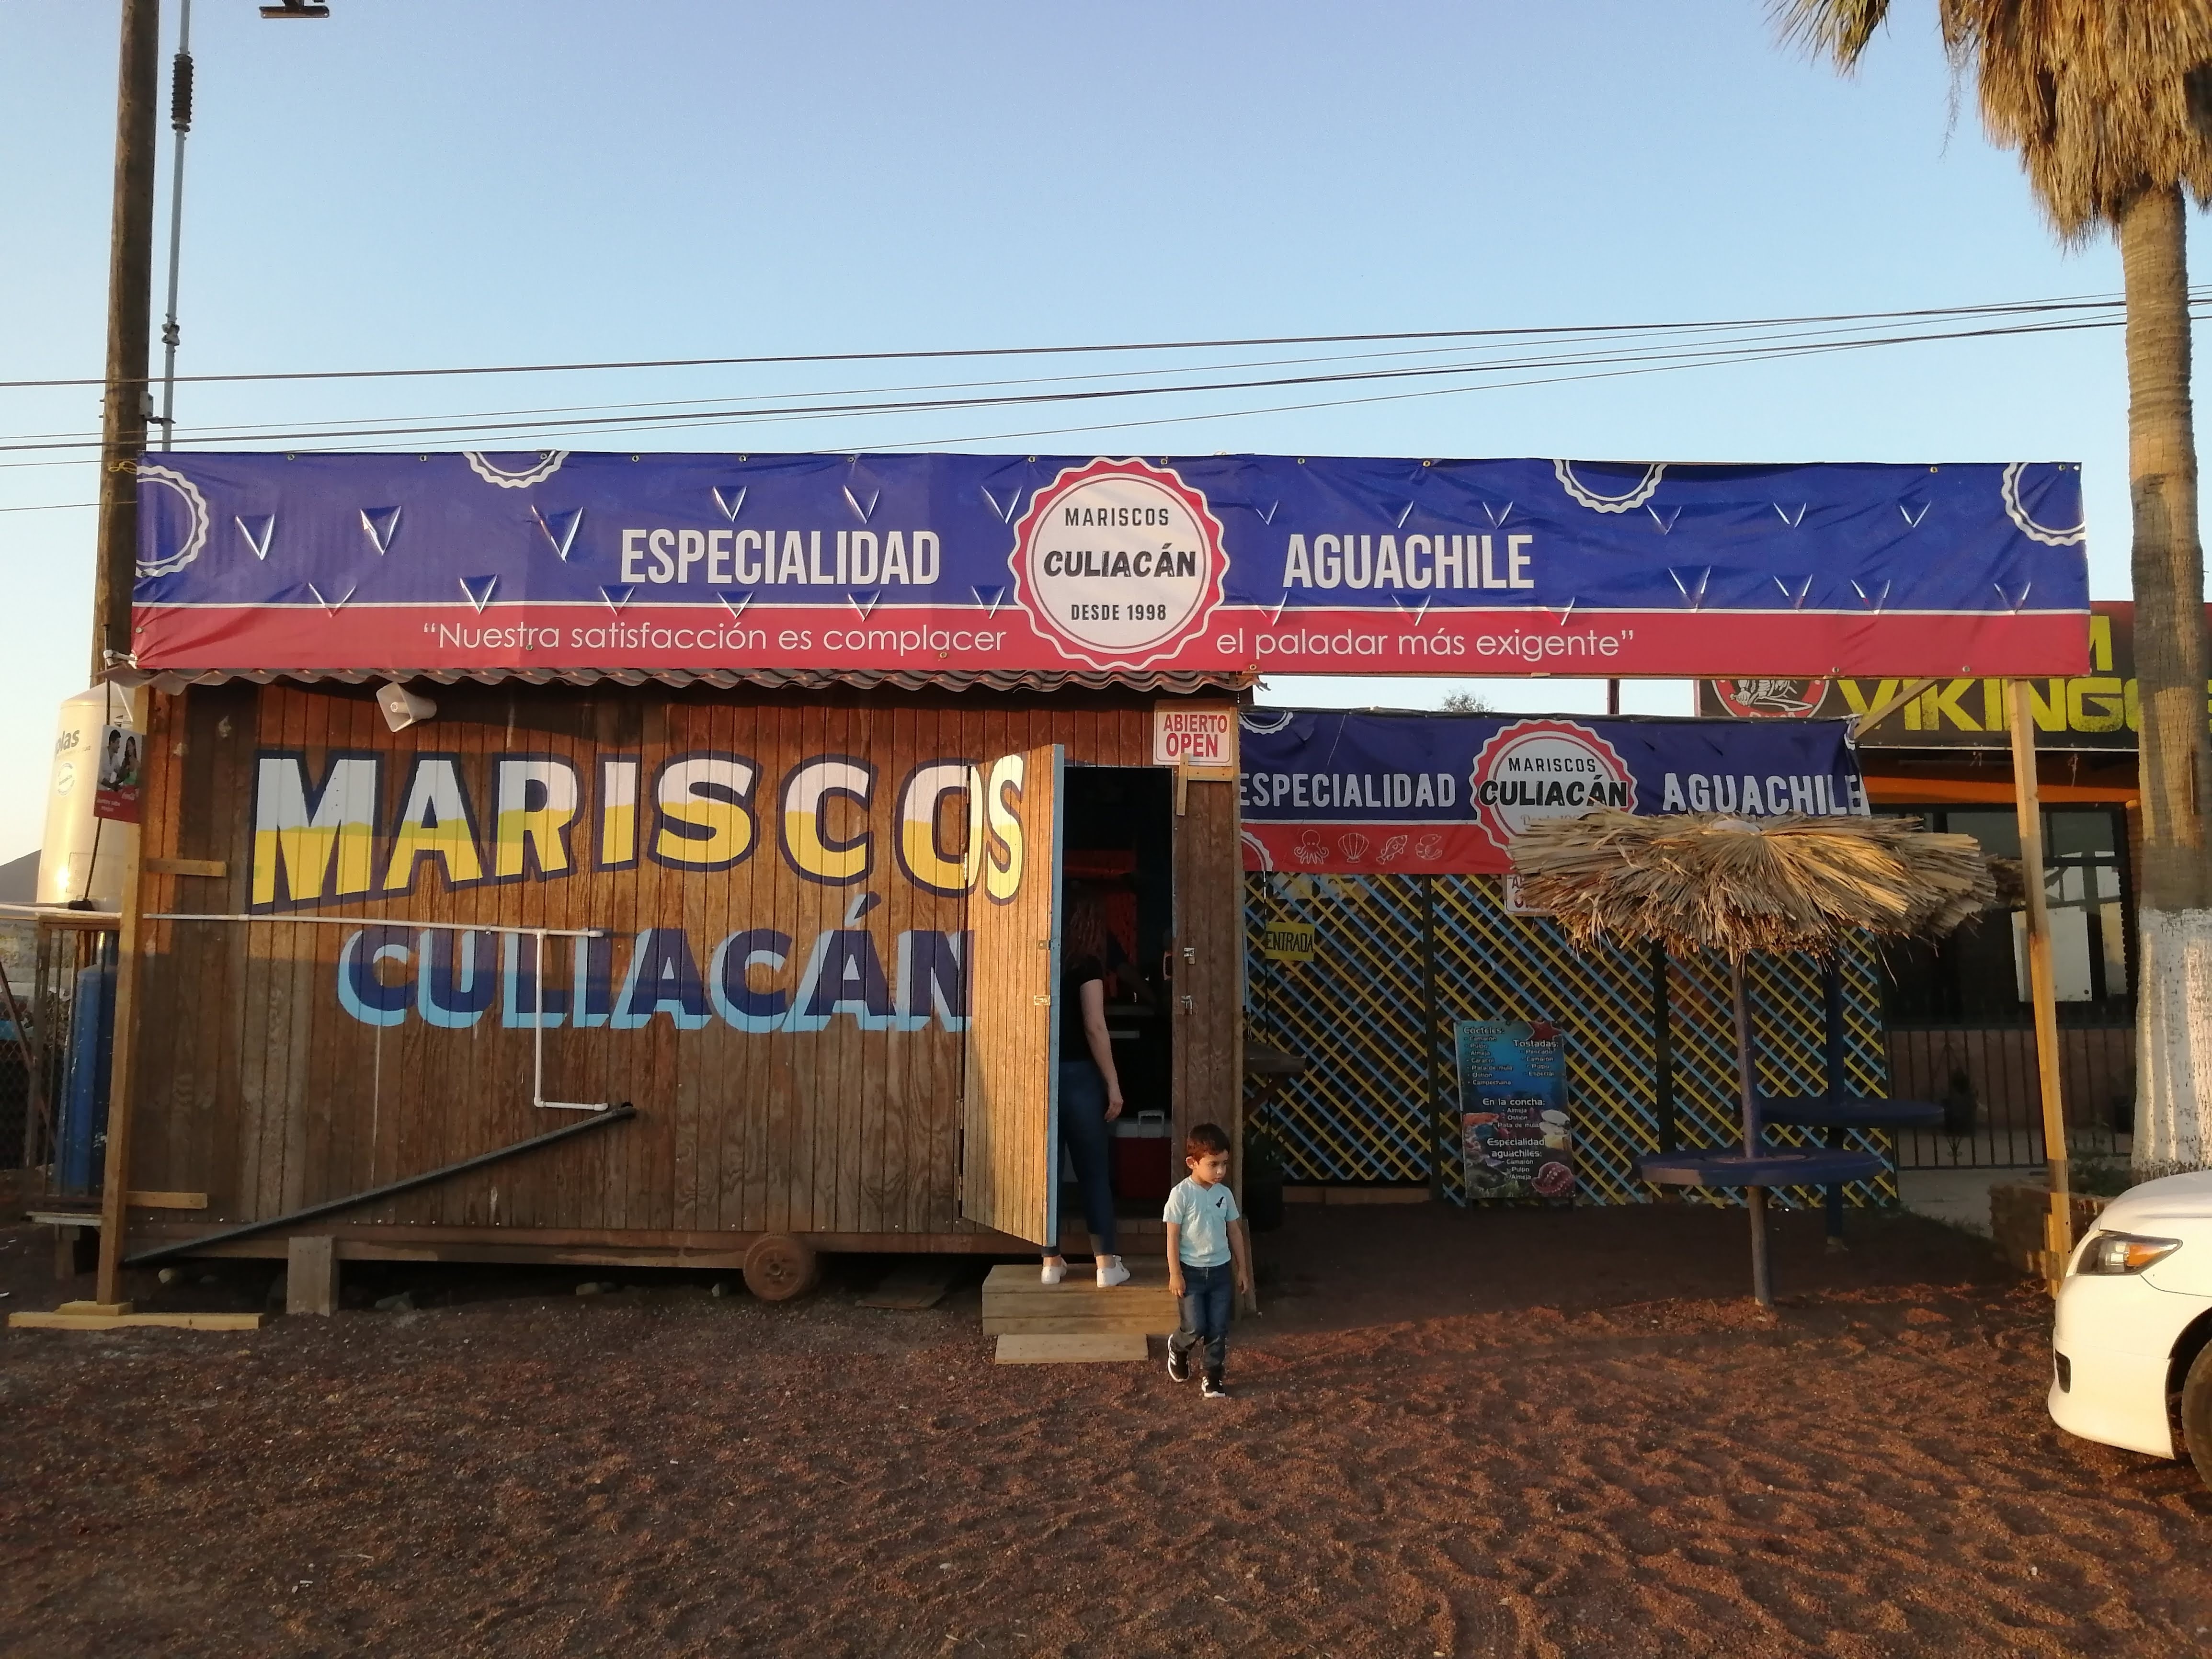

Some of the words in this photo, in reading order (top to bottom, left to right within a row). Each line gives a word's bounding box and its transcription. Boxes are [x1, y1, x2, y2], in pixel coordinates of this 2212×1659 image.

[1065, 508, 1169, 527] MARISCOS
[621, 529, 940, 585] ESPECIALIDAD
[1043, 542, 1197, 578] CULIACÁN
[1283, 534, 1534, 589] AGUACHILE
[1071, 604, 1120, 621] DESDE
[1126, 604, 1166, 621] 1998
[571, 622, 766, 650] satisfacción
[778, 629, 812, 650] es
[823, 624, 1007, 657] complacer
[1216, 627, 1243, 654] el
[1255, 628, 1388, 660] paladar
[1398, 627, 1465, 656] más
[1837, 677, 2138, 733] VIKING
[1163, 714, 1227, 733] ABIERTO
[1166, 732, 1218, 758] OPEN
[1508, 757, 1596, 773] MARISCOS
[1240, 773, 1457, 808] ESPECIALIDAD
[1479, 774, 1627, 807] CULIACÁN
[1662, 772, 1863, 816] AGUACHILE
[247, 749, 1025, 915] MARISCOS
[1265, 931, 1314, 953] ENTRADA
[337, 891, 975, 1033] CULIACÁN
